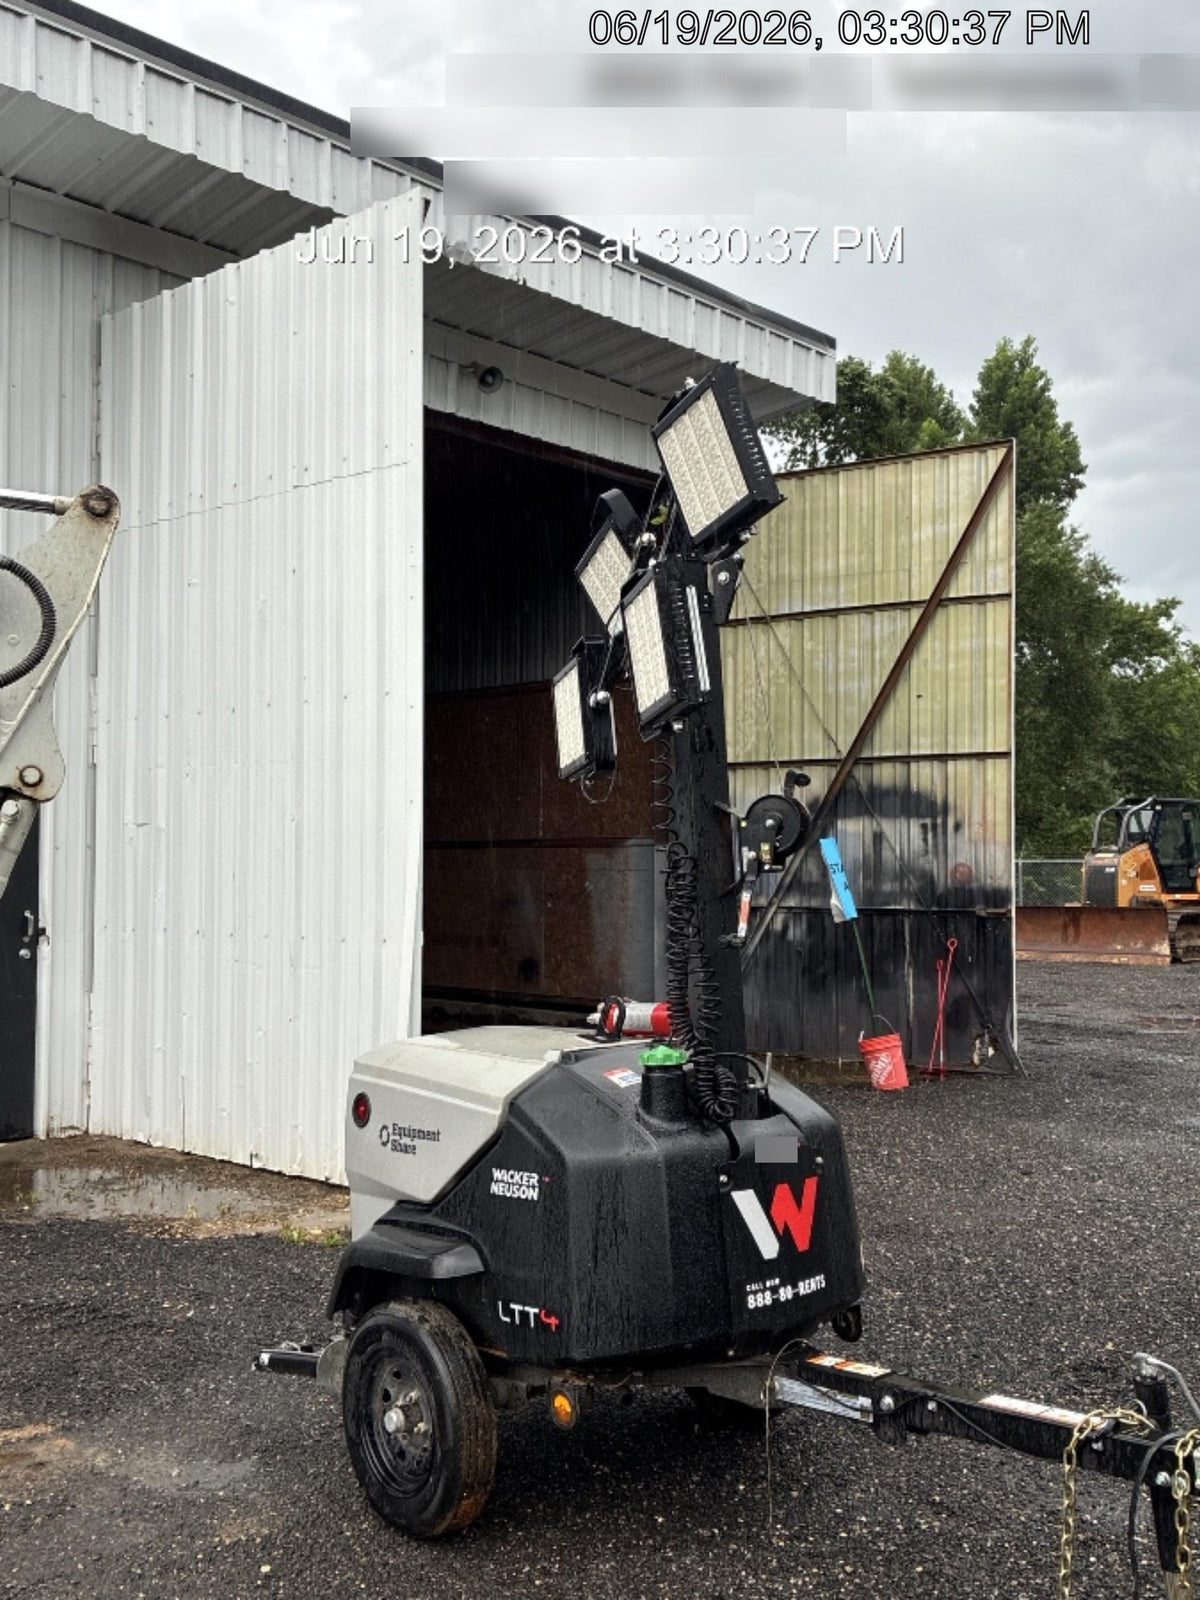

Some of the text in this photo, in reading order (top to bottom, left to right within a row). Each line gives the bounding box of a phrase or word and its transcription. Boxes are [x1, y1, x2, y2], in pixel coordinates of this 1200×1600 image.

[392, 1123, 441, 1142] Equipment
[391, 1139, 416, 1155] Share
[491, 1167, 539, 1187] WACKER
[490, 1181, 539, 1200] NEUSON
[747, 1274, 826, 1309] 888-80-RENTS
[498, 1300, 559, 1333] LTT4
